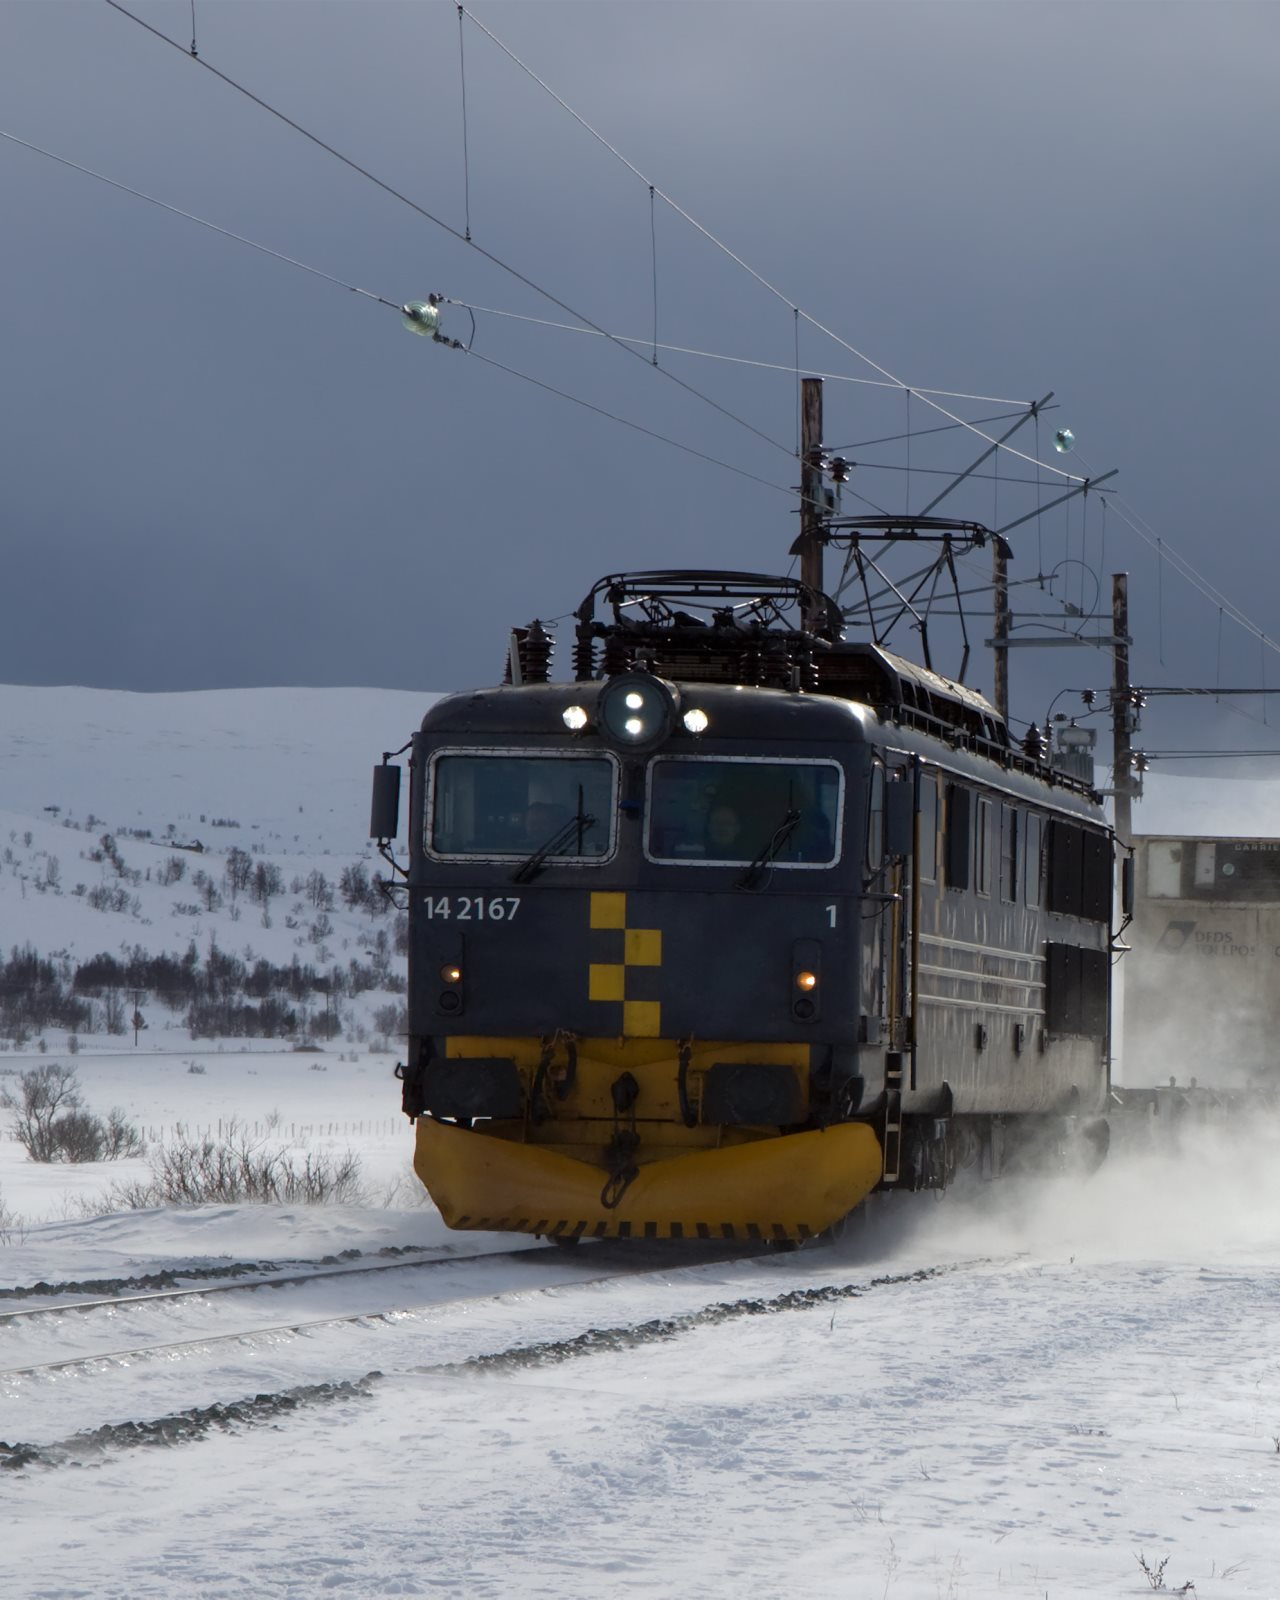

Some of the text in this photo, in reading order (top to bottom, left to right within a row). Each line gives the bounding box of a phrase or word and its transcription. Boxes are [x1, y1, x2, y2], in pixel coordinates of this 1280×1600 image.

[423, 896, 521, 921] 14 2167
[825, 904, 837, 928] 1
[1195, 931, 1233, 944] DFDS
